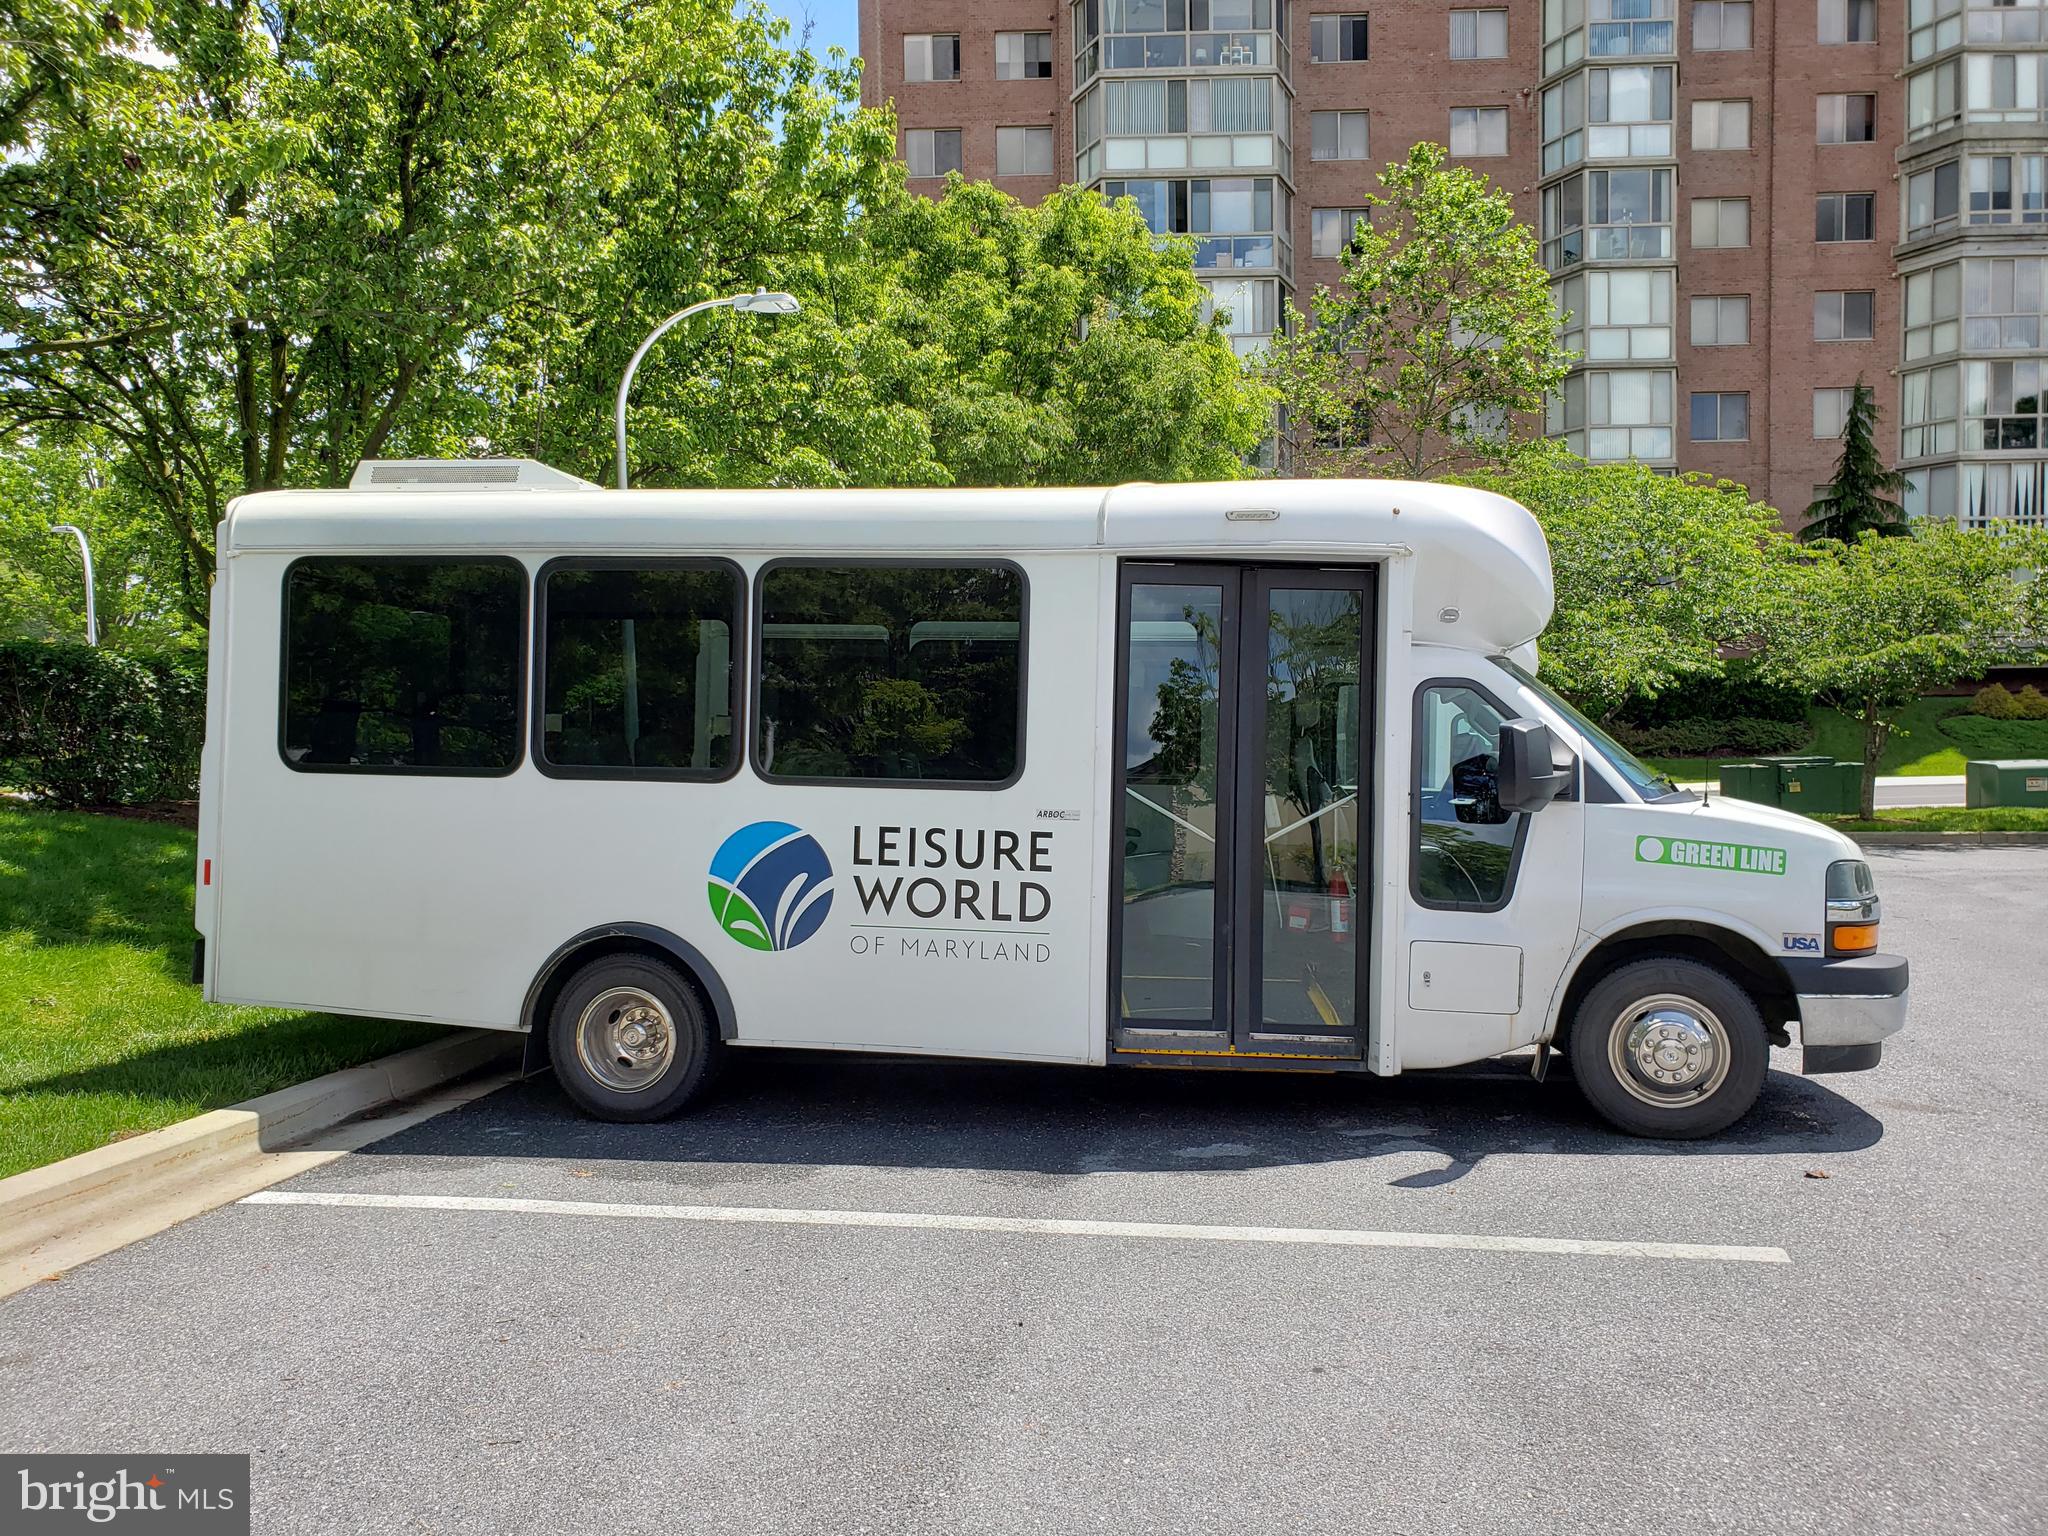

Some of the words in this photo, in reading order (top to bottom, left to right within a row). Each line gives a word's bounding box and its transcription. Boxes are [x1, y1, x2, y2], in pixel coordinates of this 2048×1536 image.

[1036, 809, 1066, 819] ARBOC
[852, 825, 1054, 873] LEISURE
[1670, 840, 1736, 868] GREEN
[1739, 848, 1784, 873] LINE
[852, 875, 1052, 923] WORLD
[849, 934, 887, 955] OF
[900, 937, 1051, 964] MARYLAND
[1783, 936, 1820, 951] USA
